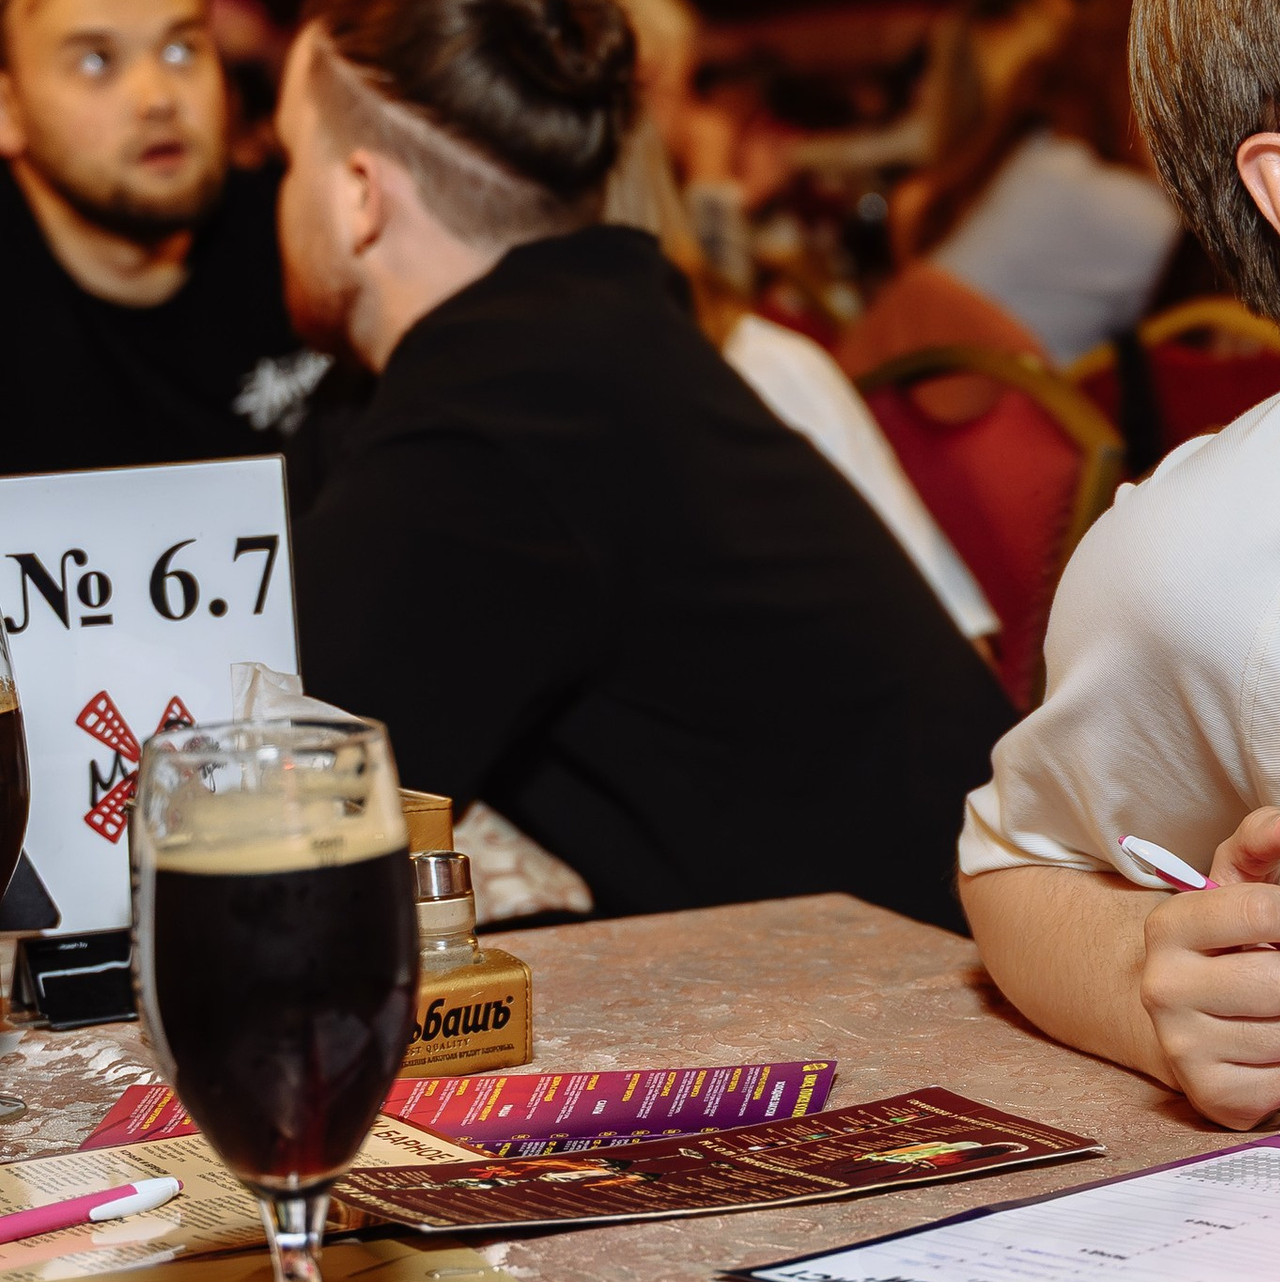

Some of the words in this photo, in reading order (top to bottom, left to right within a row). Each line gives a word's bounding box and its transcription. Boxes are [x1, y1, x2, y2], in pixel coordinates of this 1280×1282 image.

[4, 548, 114, 634] №
[150, 535, 279, 621] 6.7
[426, 1037, 471, 1055] QUALITY
[373, 1130, 456, 1162] БАРНОЕ
